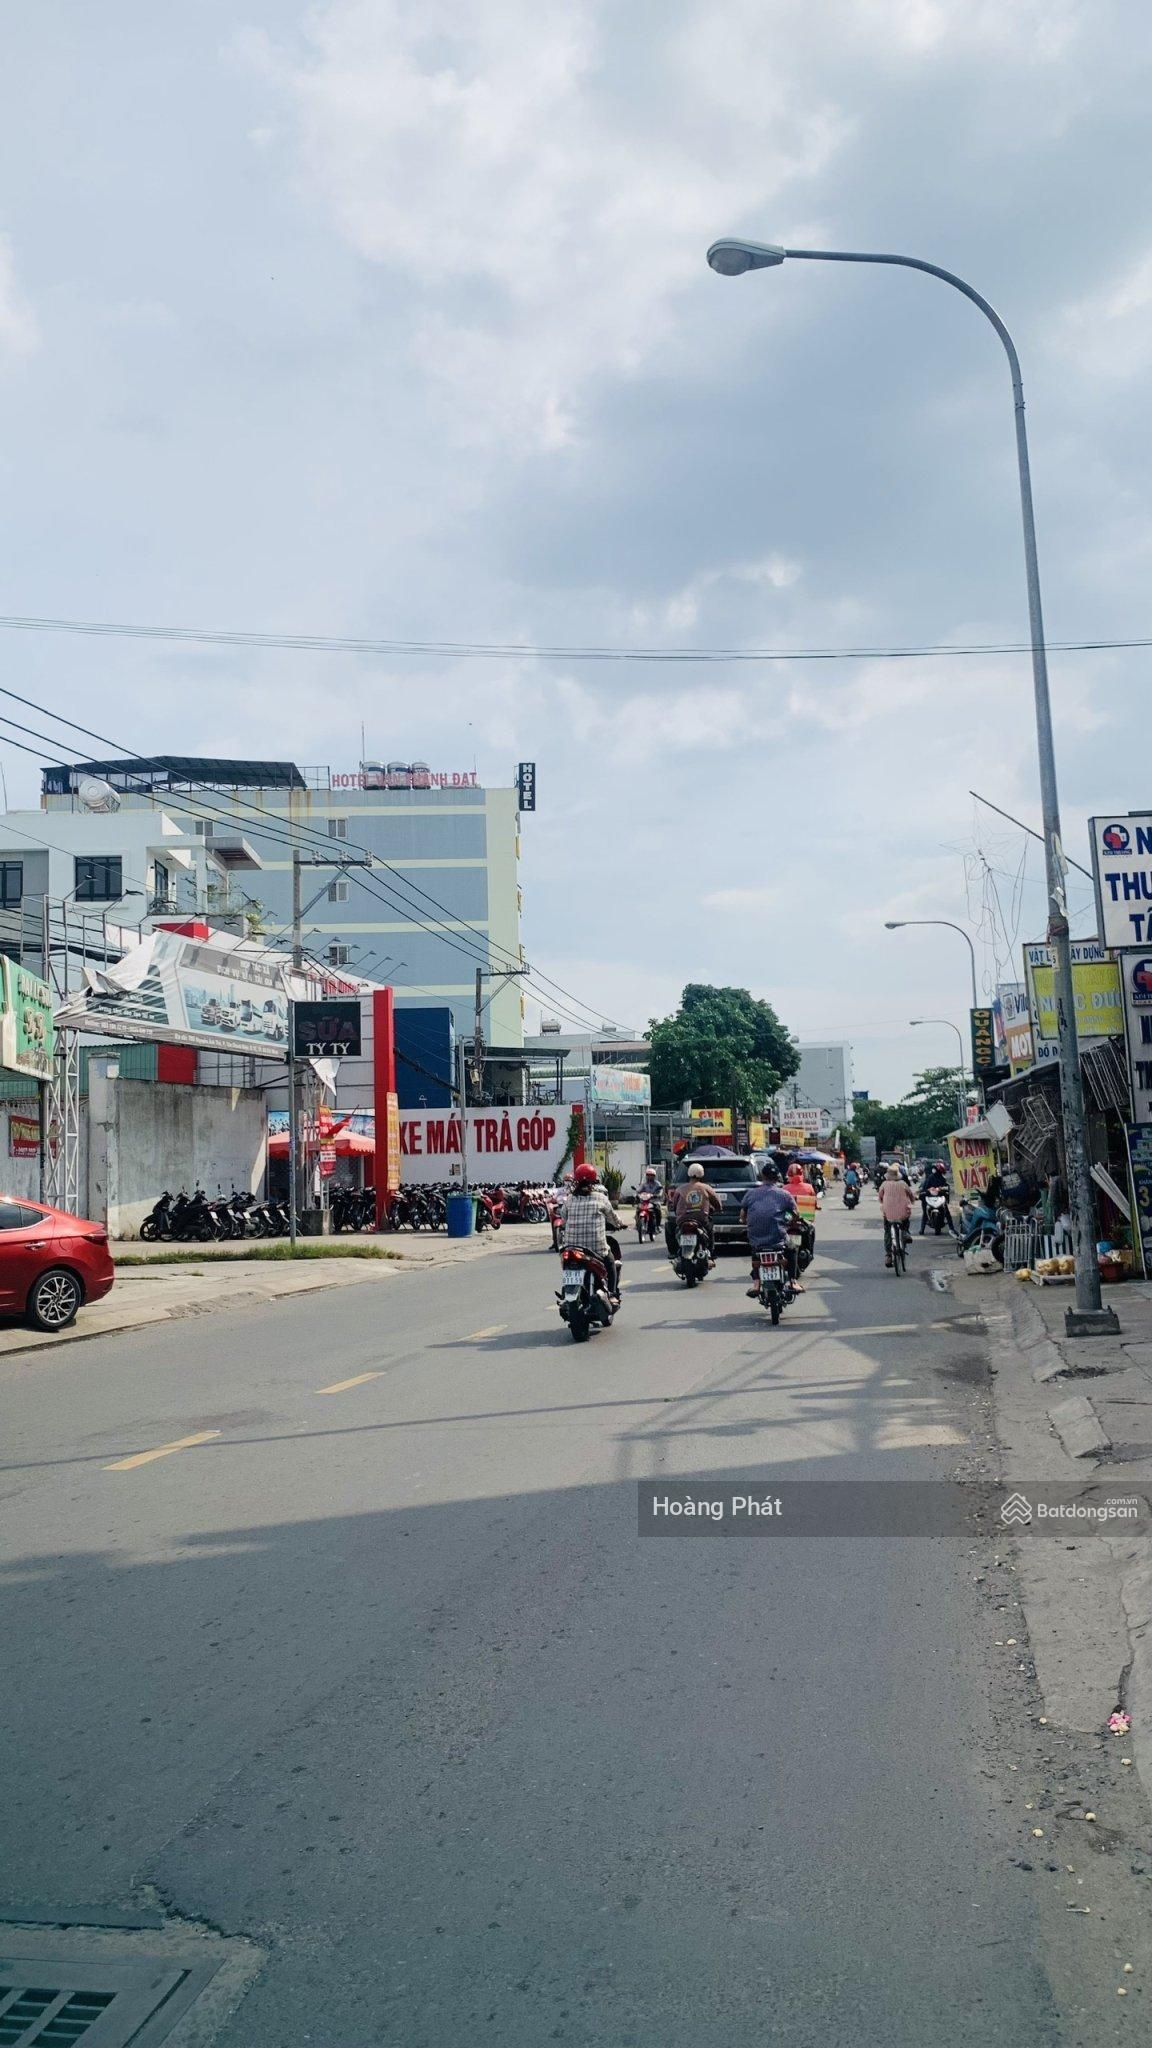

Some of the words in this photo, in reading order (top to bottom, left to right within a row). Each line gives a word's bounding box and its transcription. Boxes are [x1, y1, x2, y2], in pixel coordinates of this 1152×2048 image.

[521, 763, 532, 809] HOTEL
[306, 1043, 327, 1055] TY
[330, 1043, 350, 1055] TY
[698, 1110, 725, 1119] GYM
[426, 1112, 468, 1154] MÁY
[474, 1110, 513, 1152] TRẢ
[517, 1109, 556, 1151] GÓP
